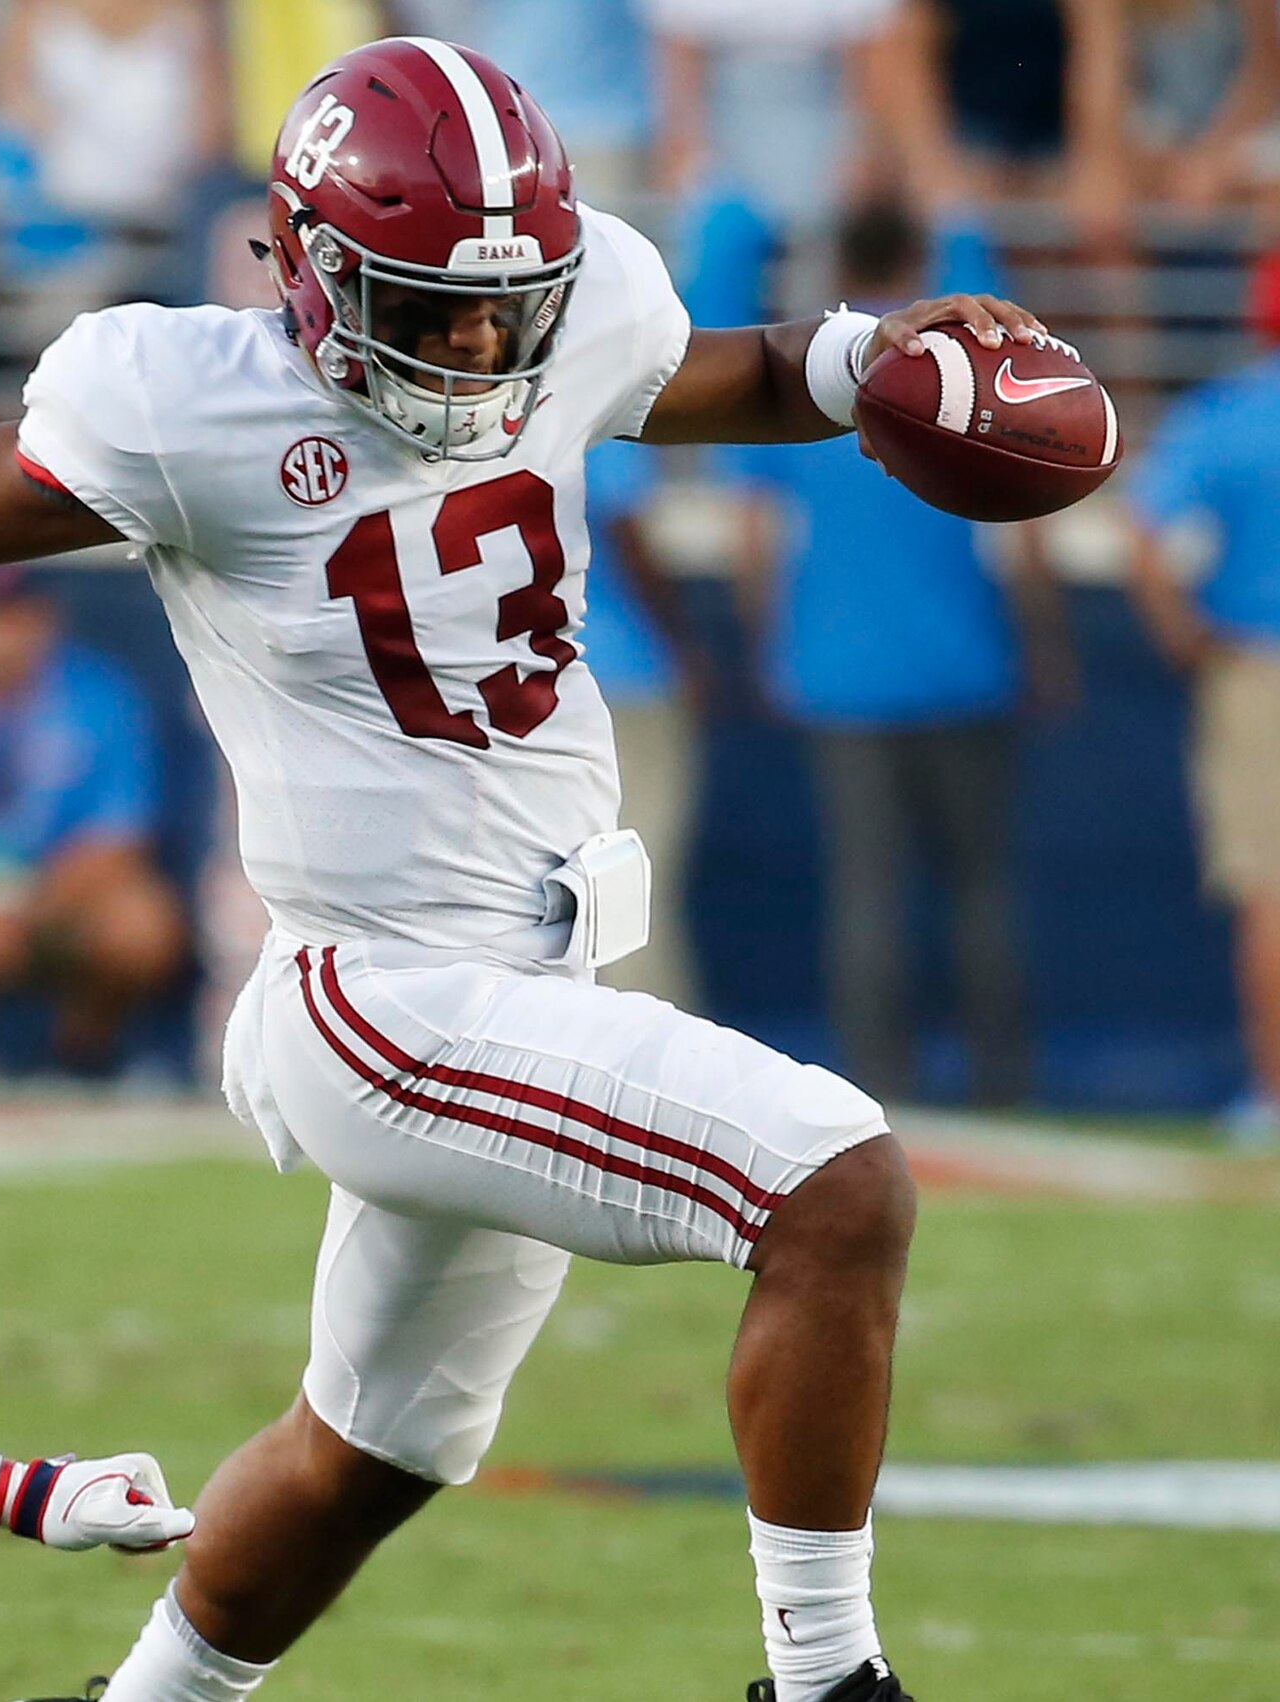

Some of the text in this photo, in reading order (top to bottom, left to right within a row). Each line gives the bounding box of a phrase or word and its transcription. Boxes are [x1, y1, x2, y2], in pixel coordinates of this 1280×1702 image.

[283, 93, 355, 191] 13
[477, 245, 525, 260] BAMA
[283, 440, 346, 503] SEC
[325, 468, 578, 751] 13
